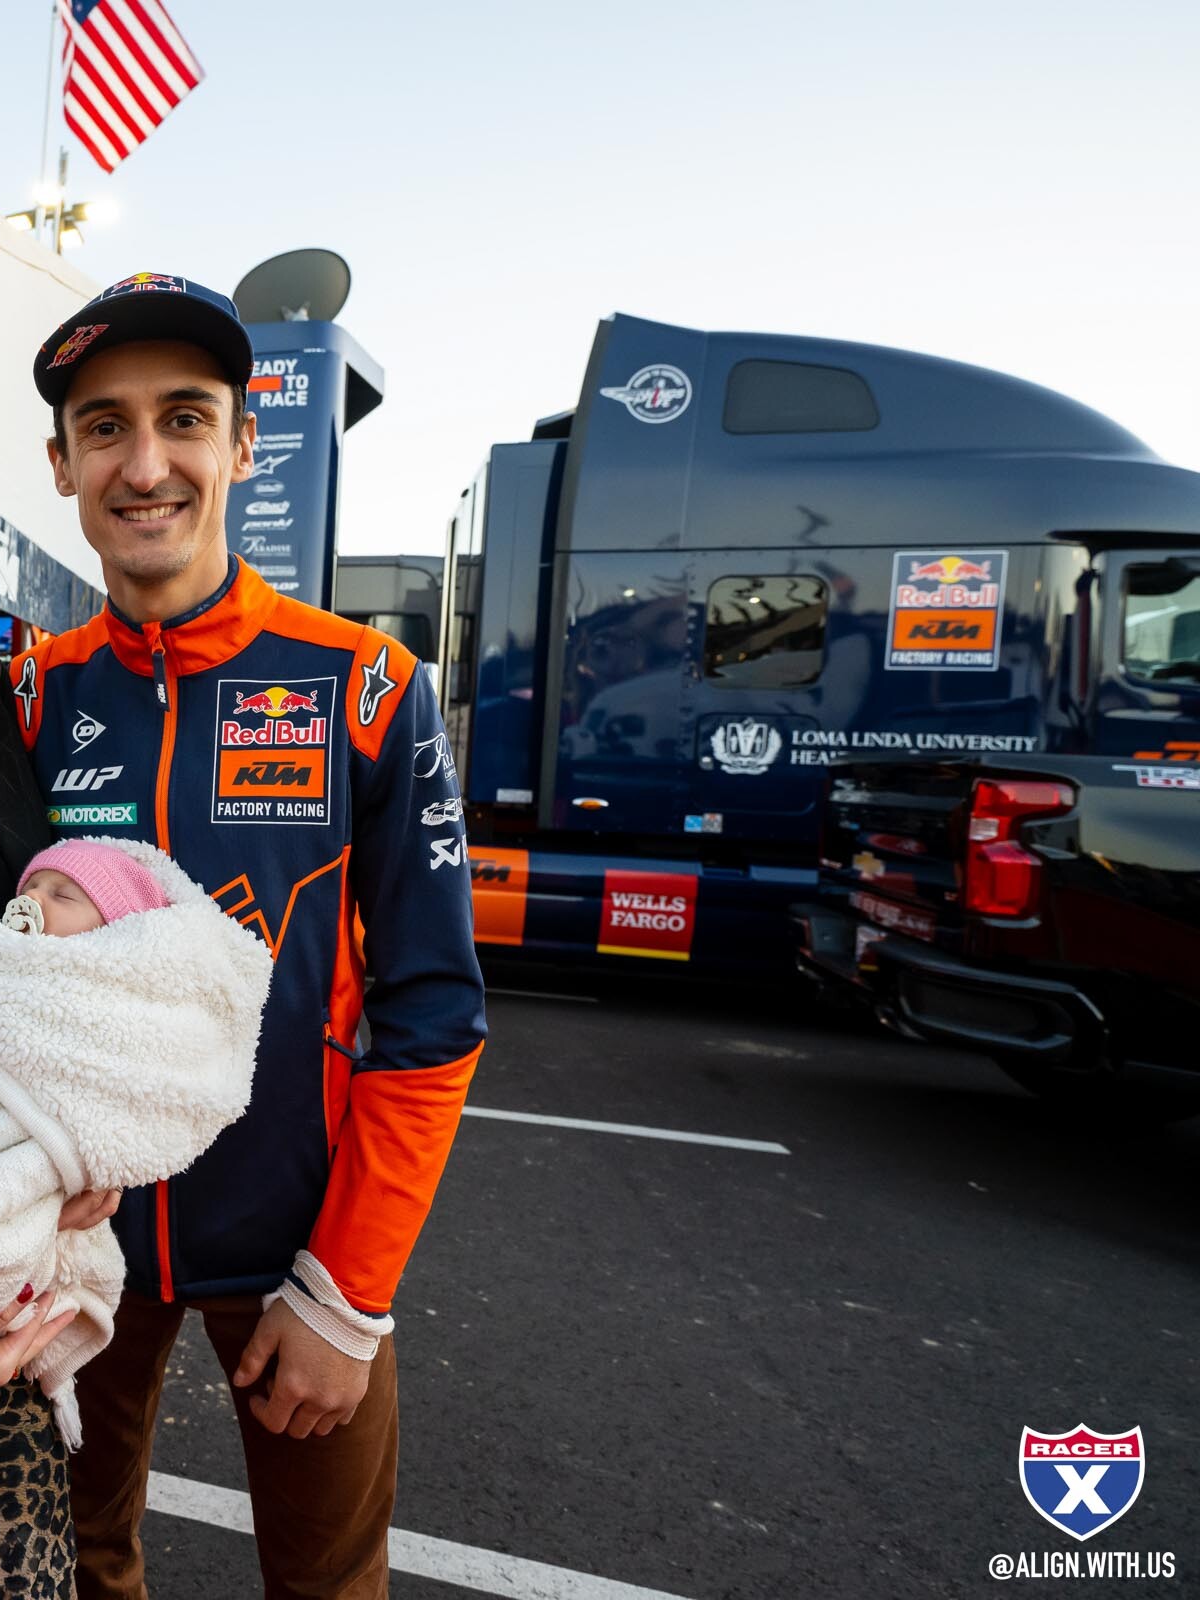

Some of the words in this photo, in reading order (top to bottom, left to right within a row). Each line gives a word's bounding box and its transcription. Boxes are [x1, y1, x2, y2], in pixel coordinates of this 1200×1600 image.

[252, 358, 298, 377] EADY
[284, 374, 309, 391] TO
[259, 390, 308, 408] RACE
[896, 584, 947, 608] Red
[947, 583, 999, 608] Bull
[907, 619, 981, 640] KTM
[891, 651, 944, 665] FACTORY
[945, 651, 993, 666] RACING
[221, 719, 274, 746] Red
[274, 717, 327, 745] Bull
[792, 729, 848, 747] LOMA
[851, 731, 913, 749] LINDA
[915, 732, 1037, 752] UNIVERSITY
[790, 750, 836, 766] HEA
[50, 765, 125, 792] WP
[232, 761, 312, 786] KTM
[61, 806, 133, 823] MOTOREX
[216, 802, 272, 817] FACTORY
[276, 802, 325, 817] RACING
[610, 891, 686, 913] WELLS
[610, 910, 686, 932] FARGO
